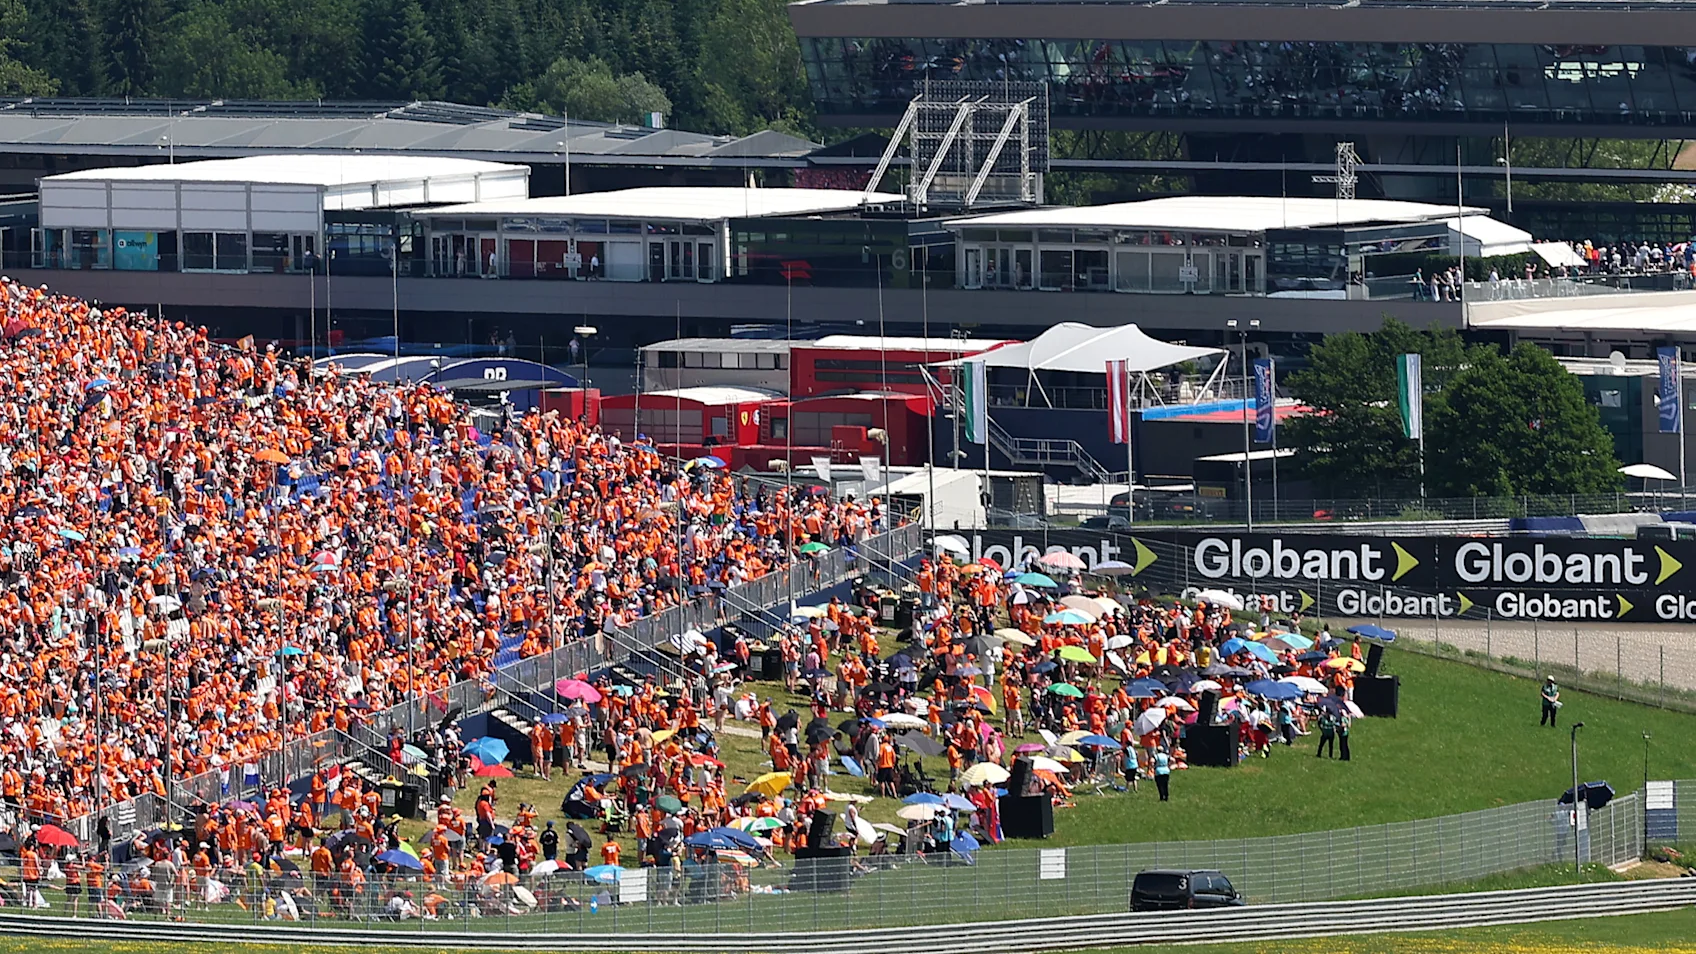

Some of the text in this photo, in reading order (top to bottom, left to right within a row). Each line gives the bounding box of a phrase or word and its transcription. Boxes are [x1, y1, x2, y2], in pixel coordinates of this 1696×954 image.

[892, 248, 906, 270] 6
[1194, 538, 1386, 580] Globant
[1455, 542, 1648, 584] Globant
[1337, 589, 1454, 616] Globant
[1496, 592, 1613, 618] Globant
[1178, 878, 1187, 890] 3
